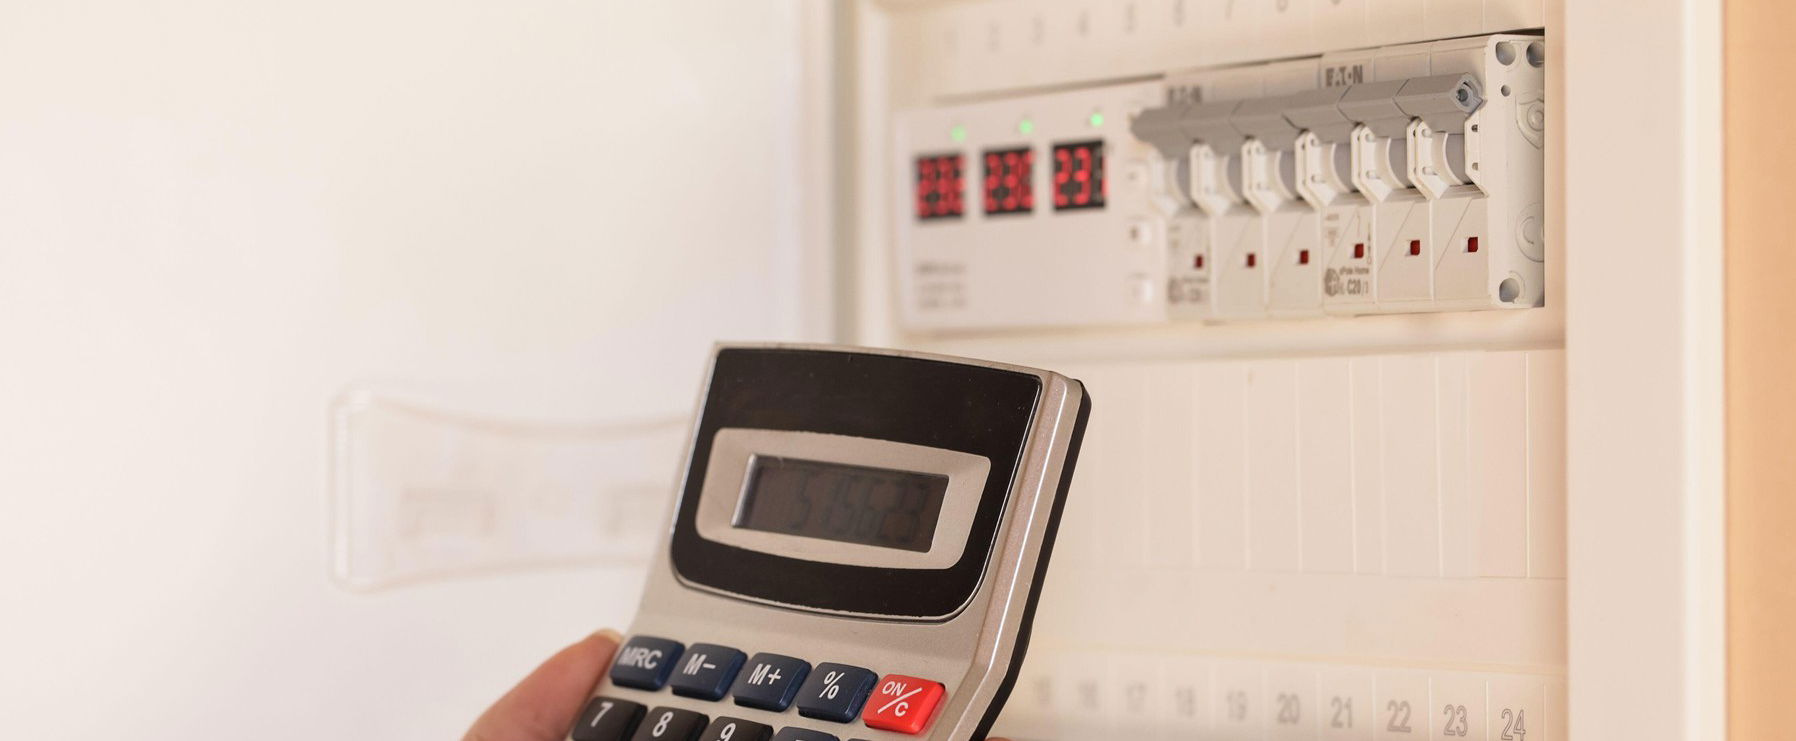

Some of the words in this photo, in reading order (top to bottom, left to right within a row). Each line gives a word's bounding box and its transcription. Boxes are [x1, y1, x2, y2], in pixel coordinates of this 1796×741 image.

[618, 646, 663, 669] MRC
[748, 663, 782, 685] M+
[823, 671, 846, 700] %
[590, 705, 607, 728] 7
[652, 711, 674, 738] 8
[716, 722, 737, 741] 9
[1226, 690, 1248, 722] 19
[1276, 693, 1301, 725] 20
[1330, 696, 1354, 729] 21
[1386, 700, 1412, 733] 22
[1442, 703, 1469, 737] 23
[1500, 708, 1527, 741] 24
